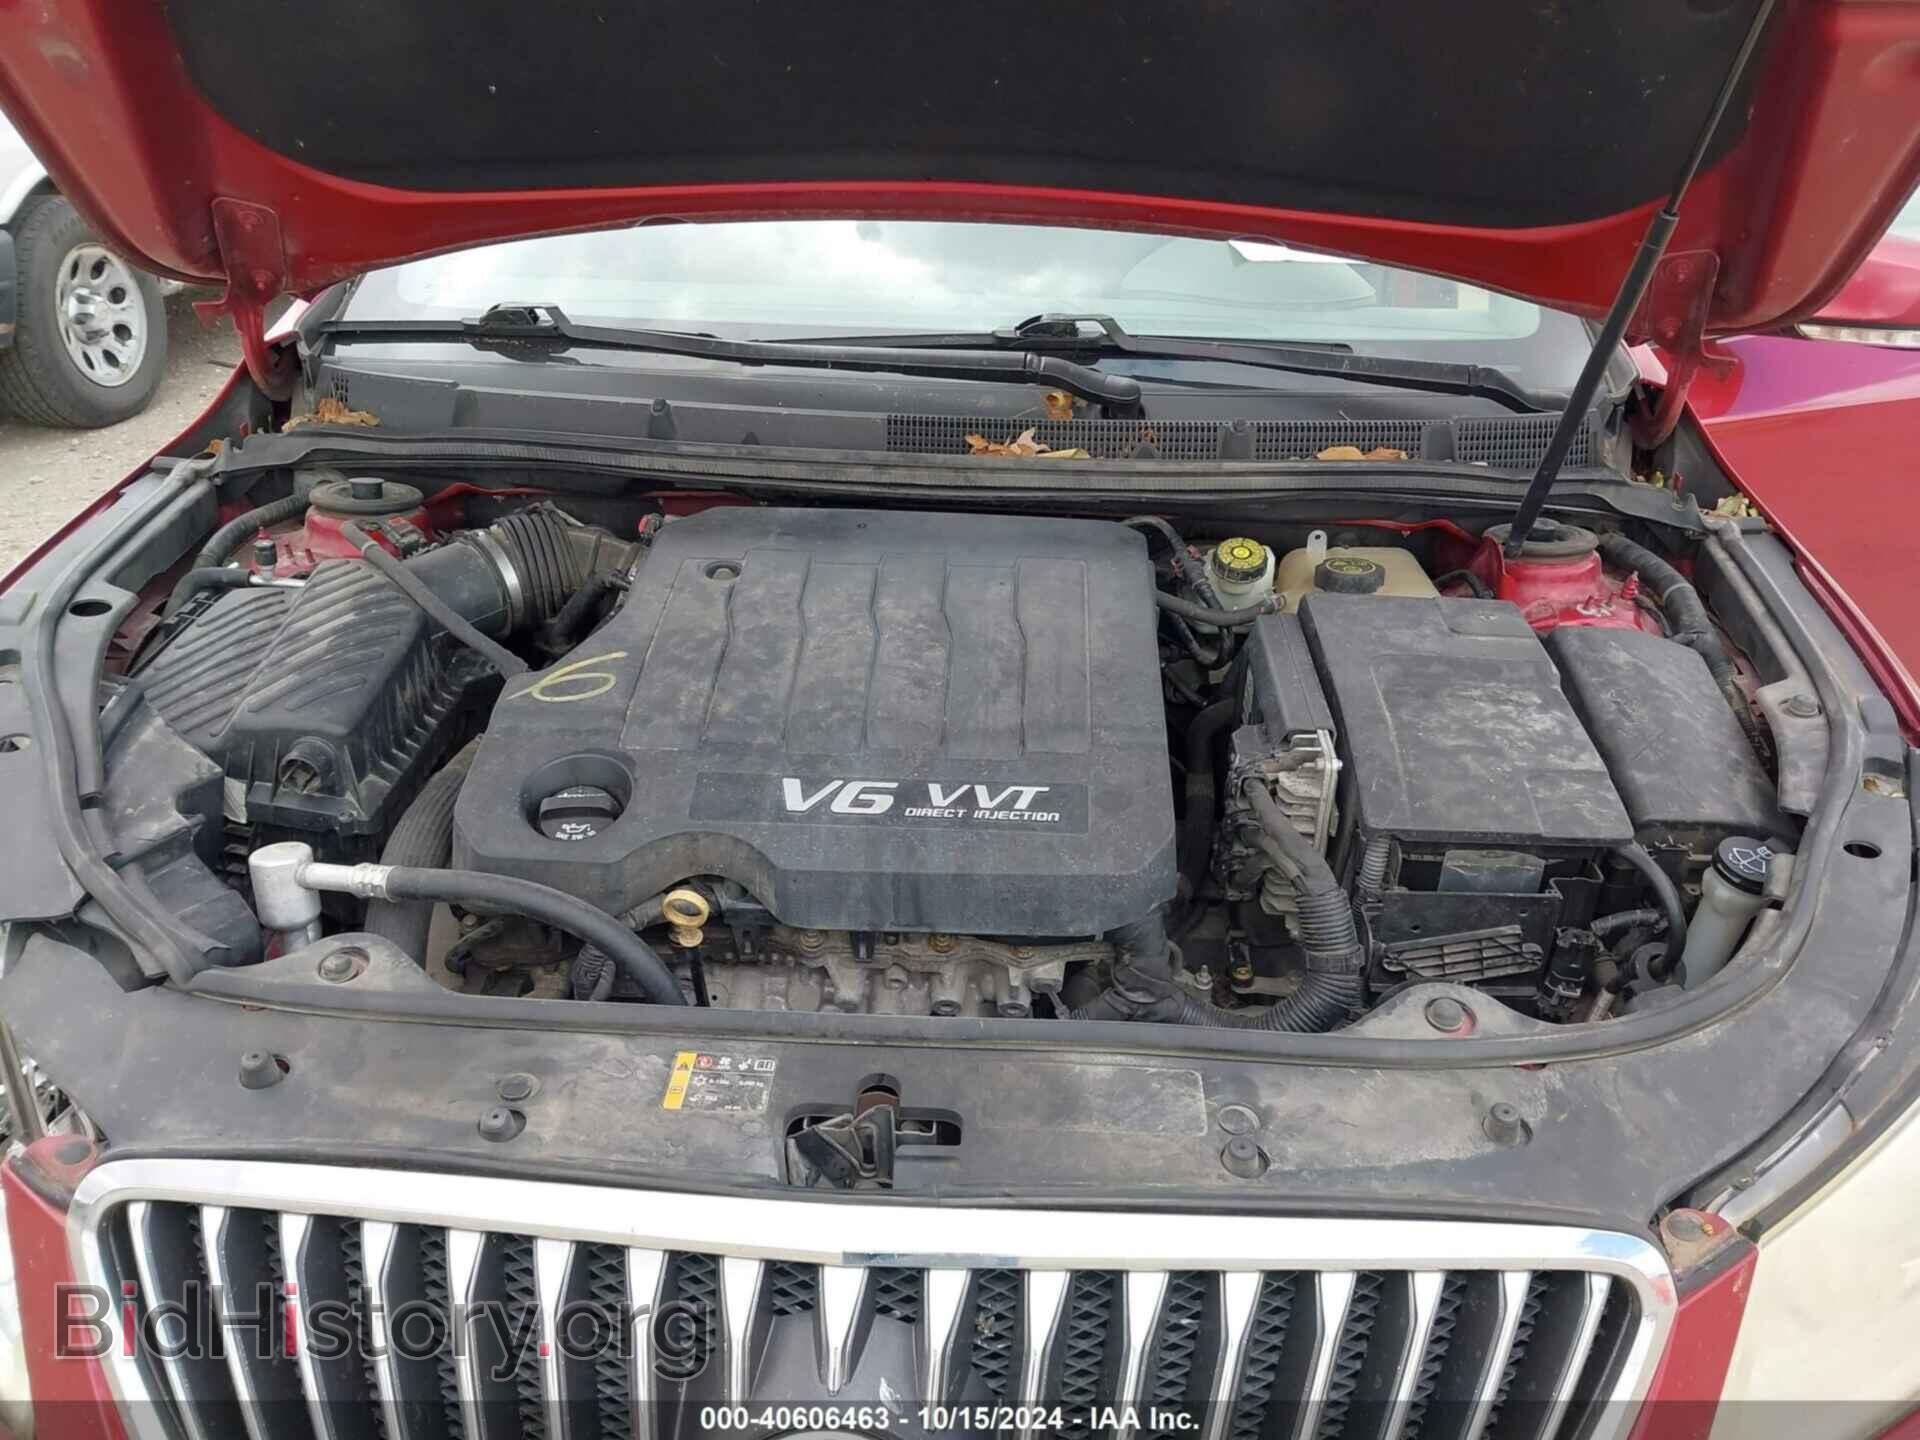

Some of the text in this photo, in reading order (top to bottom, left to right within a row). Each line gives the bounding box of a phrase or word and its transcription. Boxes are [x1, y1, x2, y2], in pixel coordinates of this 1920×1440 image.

[782, 778, 1050, 814] V6 VVT
[904, 807, 1060, 822] DIRECT INJECTION
